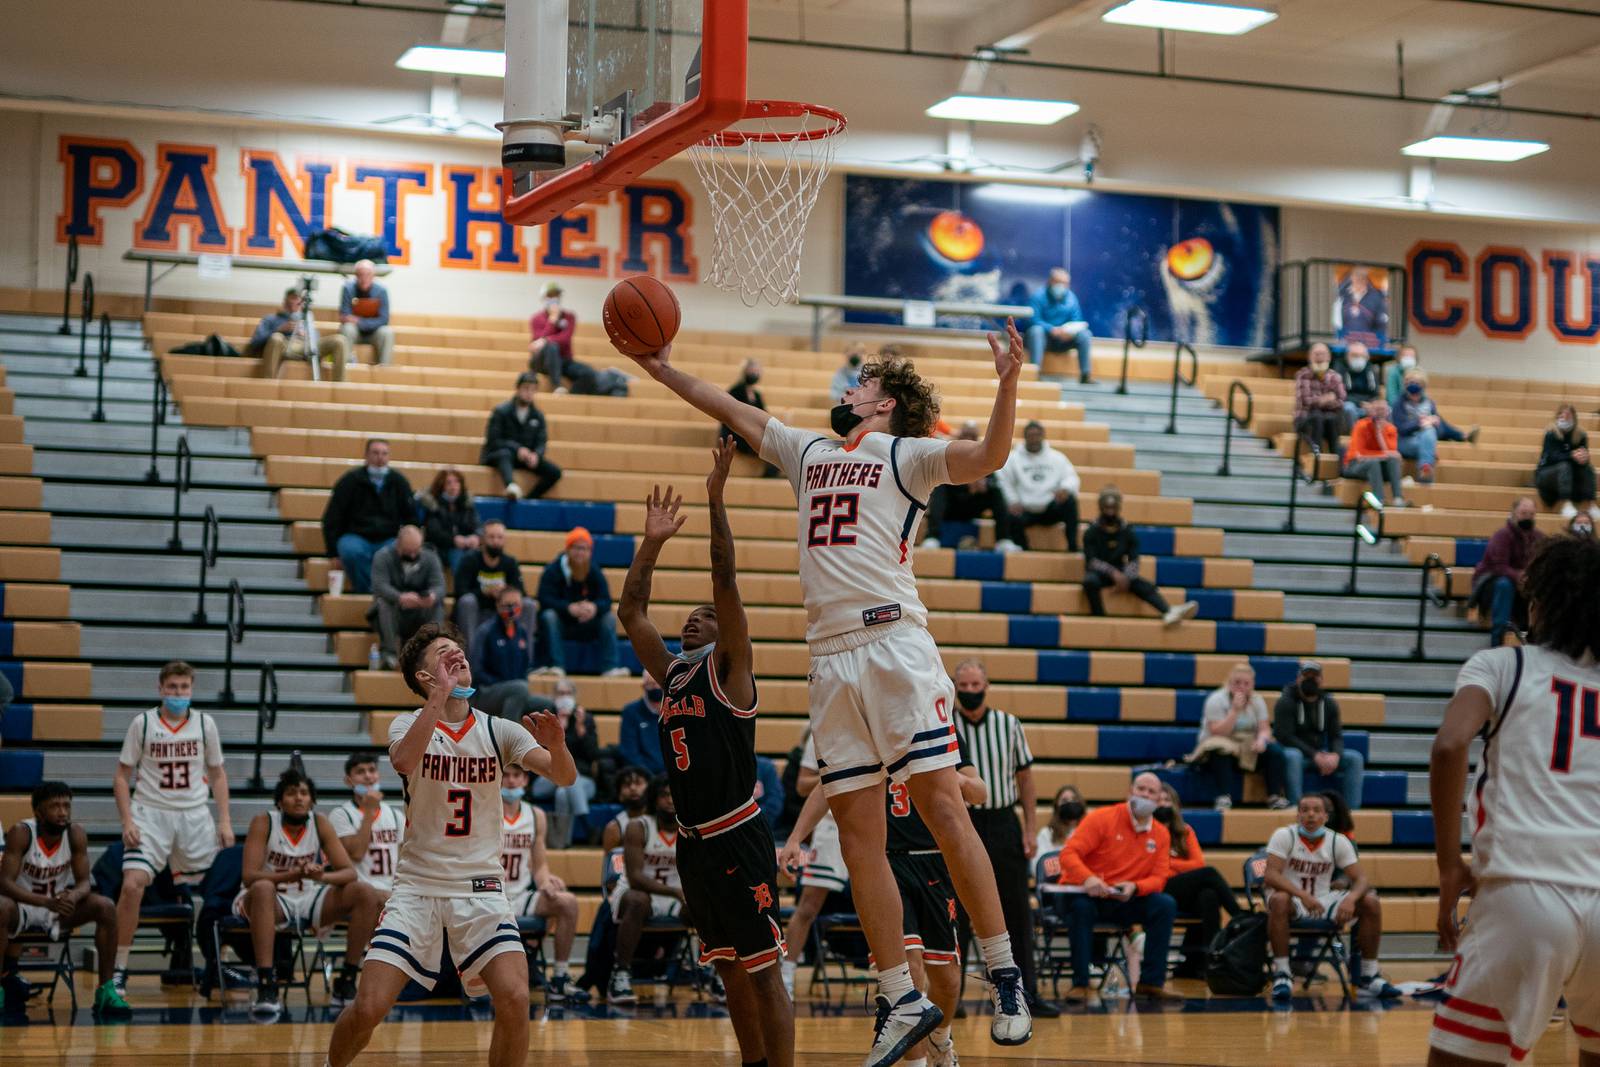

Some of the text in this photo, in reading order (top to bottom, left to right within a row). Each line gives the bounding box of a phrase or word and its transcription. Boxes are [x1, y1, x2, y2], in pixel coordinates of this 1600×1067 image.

[56, 134, 698, 284] PANTHER
[1406, 240, 1600, 344] COU
[805, 463, 884, 493] PANTHERS
[808, 493, 860, 549] 22
[150, 741, 198, 757] PANTHERS
[670, 727, 690, 771] 5
[158, 761, 190, 789] 33
[422, 753, 496, 784] PANTHERS
[445, 789, 473, 836] 3
[369, 848, 392, 876] 31
